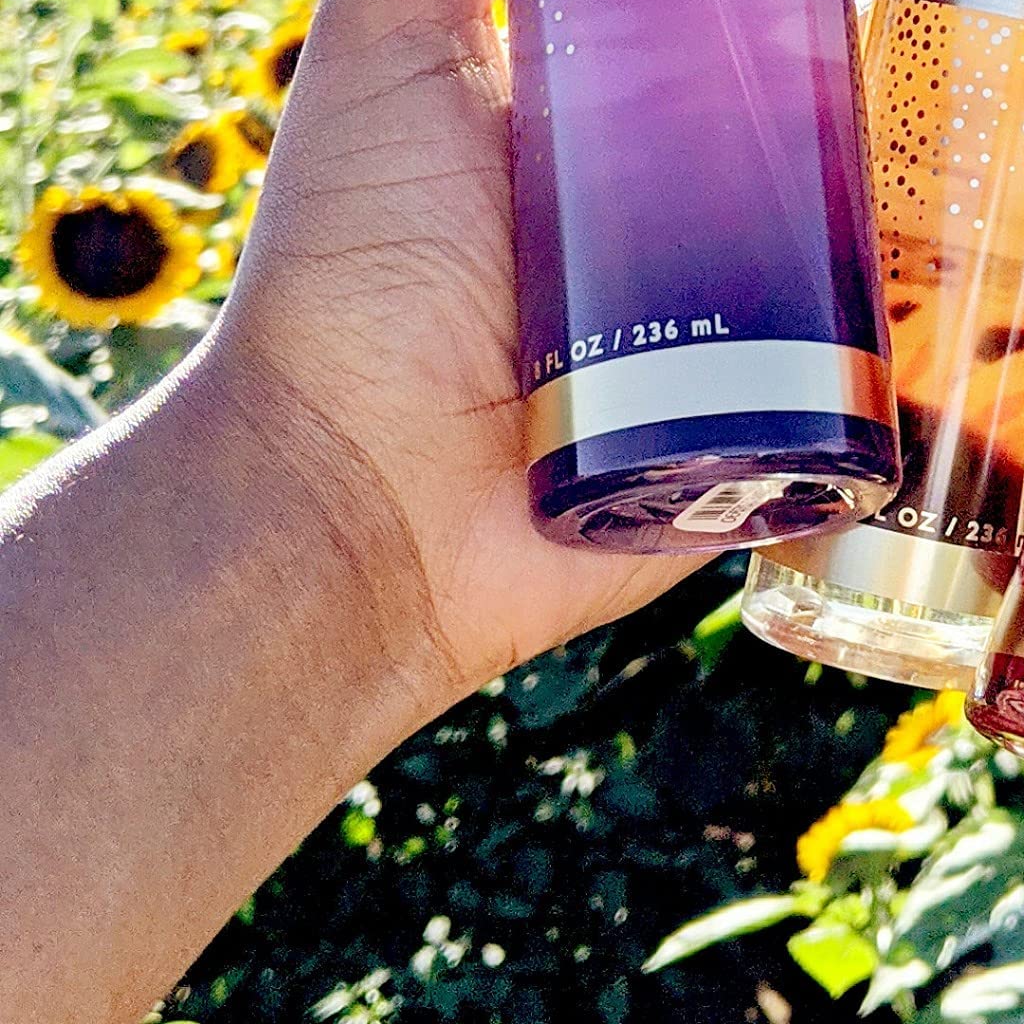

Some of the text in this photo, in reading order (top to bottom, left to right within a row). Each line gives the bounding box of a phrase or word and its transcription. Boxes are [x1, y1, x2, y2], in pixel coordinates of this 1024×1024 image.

[545, 350, 564, 374] FL
[570, 334, 605, 363] OZ
[612, 329, 622, 352] /
[632, 319, 679, 347] 236
[690, 313, 730, 338] mL
[897, 506, 939, 534] OZ
[945, 516, 958, 537] /
[965, 520, 1009, 546] 236
